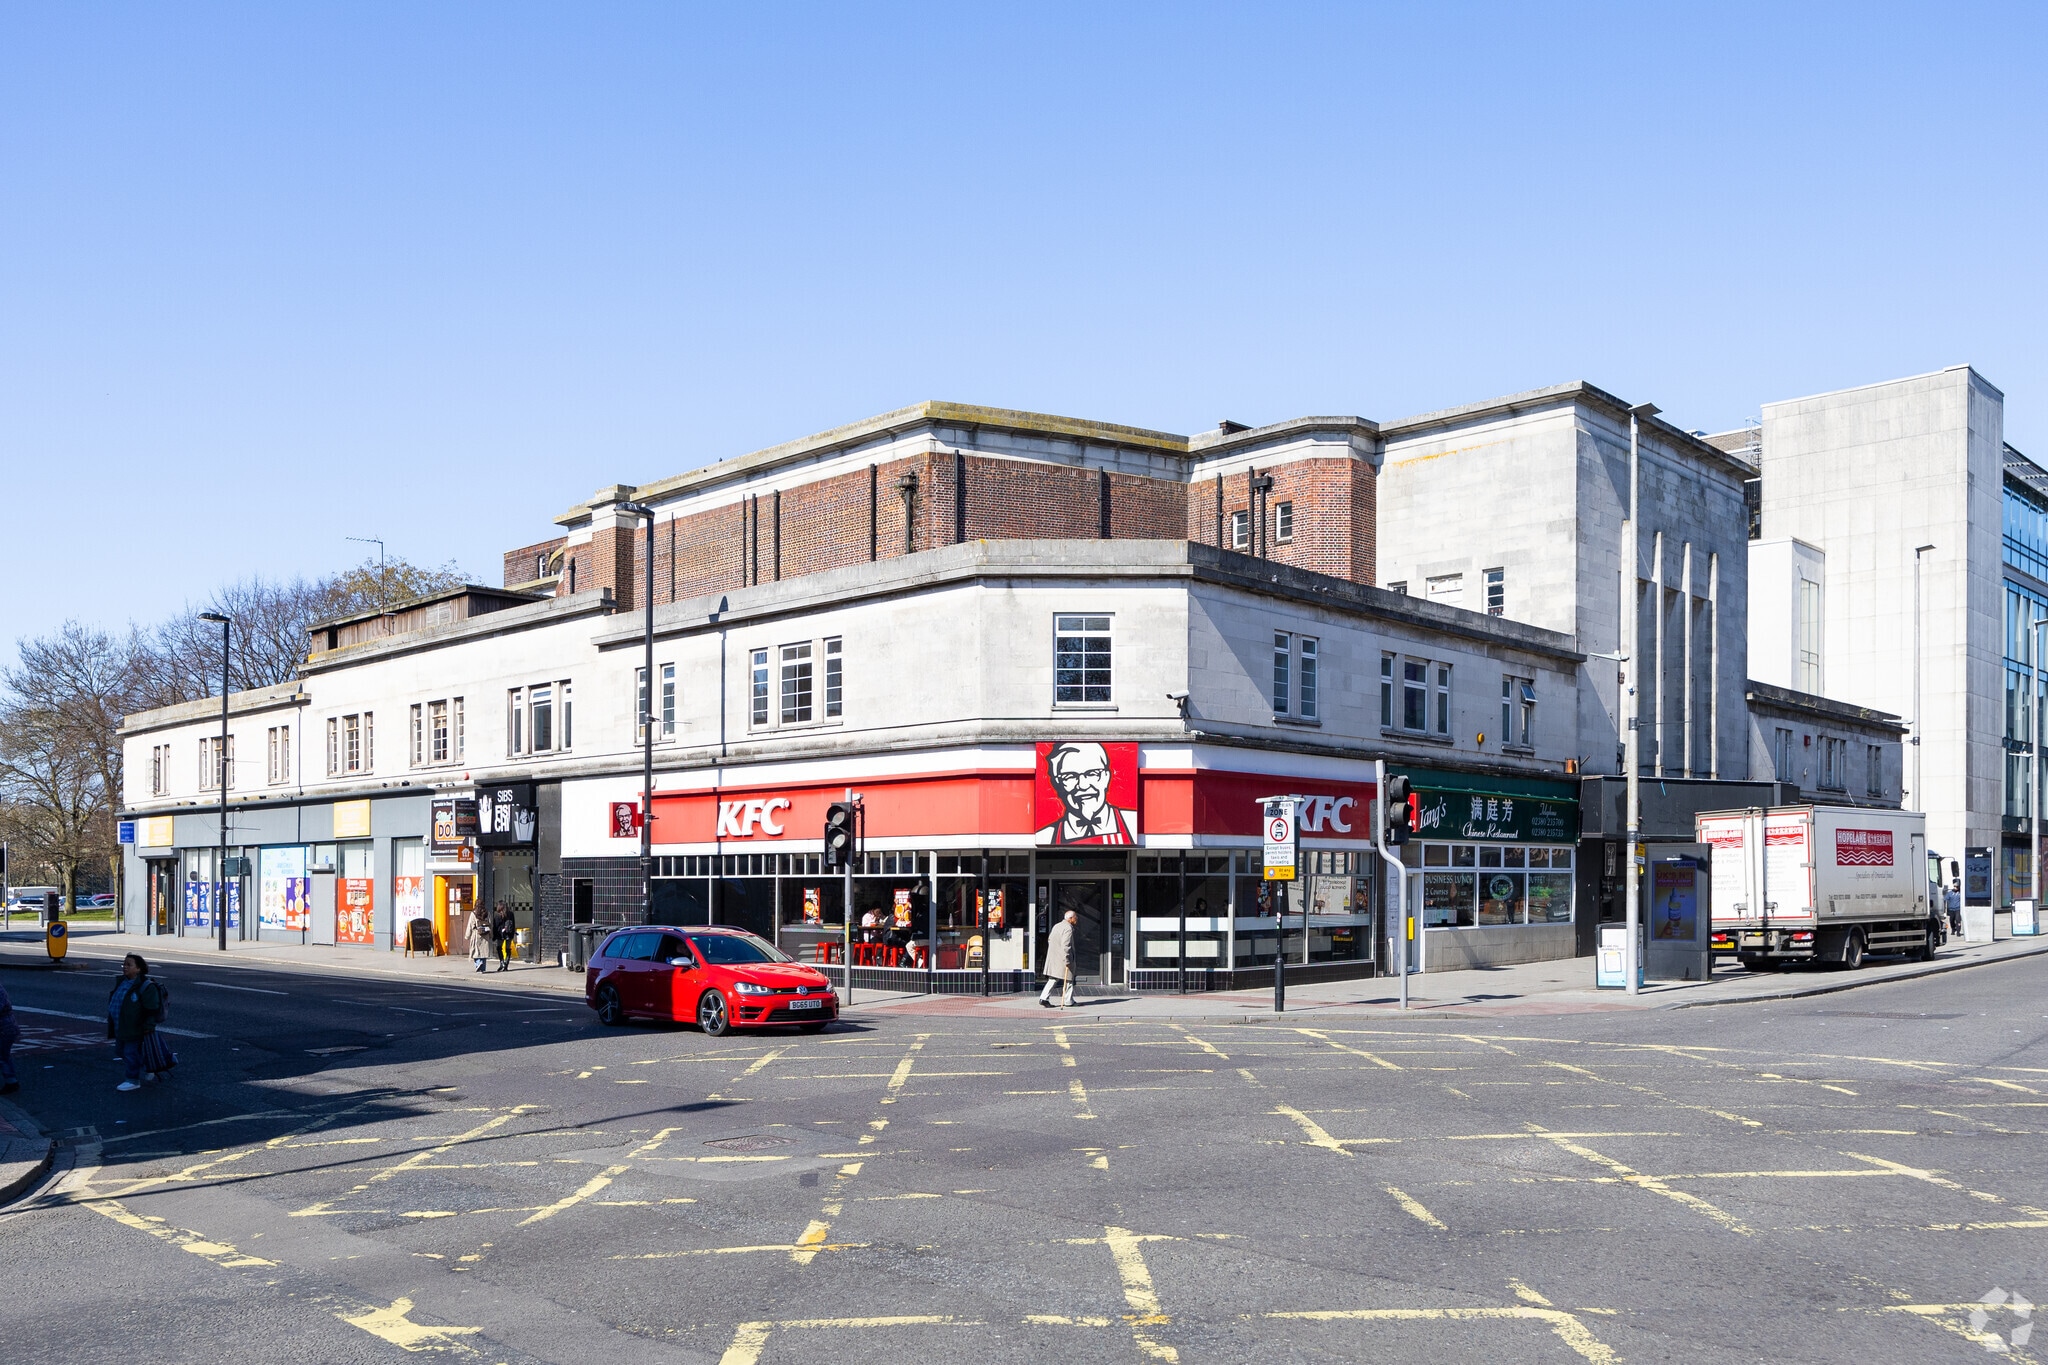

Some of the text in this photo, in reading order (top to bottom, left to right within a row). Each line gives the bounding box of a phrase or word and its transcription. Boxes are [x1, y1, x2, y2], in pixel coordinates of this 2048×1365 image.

[497, 789, 513, 802] SIBS
[717, 797, 787, 837] KFC
[1270, 808, 1288, 816] ZONE
[1289, 793, 1354, 833] KFC
[1419, 796, 1447, 829] Tang's
[494, 818, 510, 832] CHI
[1462, 821, 1519, 839] Chinese Restaurant
[1837, 830, 1867, 845] HOPELAKE
[1425, 875, 1454, 884] BUSINESS
[1657, 871, 1676, 879] UK'S
[402, 905, 421, 917] MEAT
